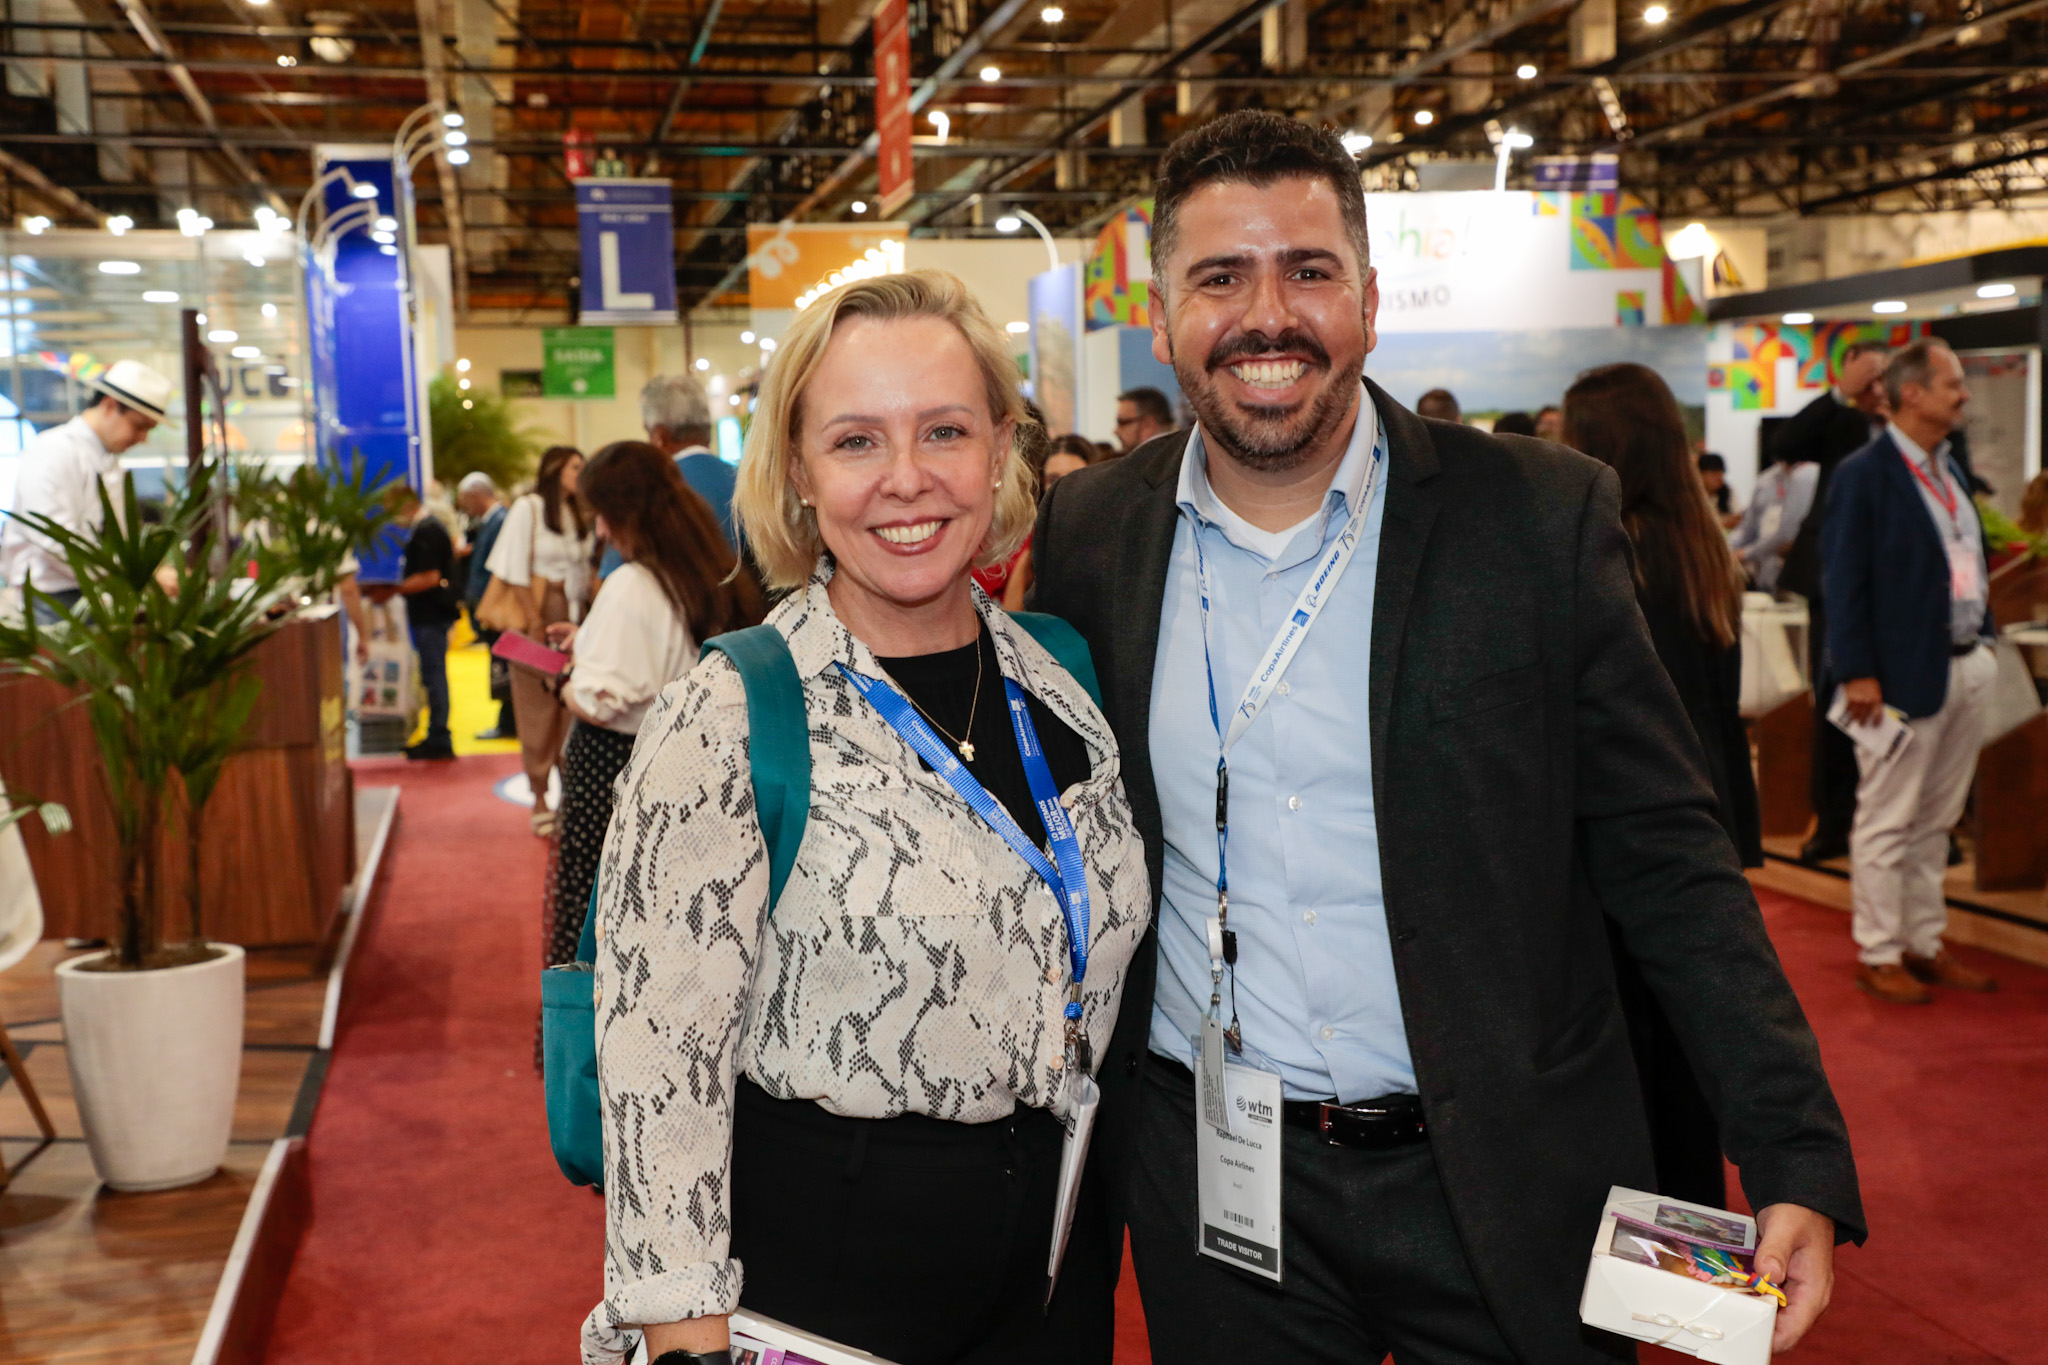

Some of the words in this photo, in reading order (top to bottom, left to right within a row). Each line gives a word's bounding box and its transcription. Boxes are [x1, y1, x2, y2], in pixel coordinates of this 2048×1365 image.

[600, 231, 655, 310] L
[1358, 460, 1376, 514] CopaAirlines
[1315, 550, 1340, 592] BOEING
[1260, 625, 1298, 682] CopaAirlines
[910, 720, 950, 761] CopaAirlines
[1016, 711, 1031, 757] CopaAirlines
[1038, 800, 1055, 832] HACEMOS
[1050, 809, 1068, 840] MEJOR
[1052, 832, 1059, 842] LO
[1248, 1100, 1273, 1117] wtm
[1238, 1134, 1245, 1144] De
[1246, 1138, 1262, 1150] Lucca
[1220, 1155, 1234, 1167] Copa
[1234, 1160, 1255, 1173] Airlines
[1217, 1237, 1237, 1251] TRADE
[1238, 1244, 1262, 1261] VISITOR
